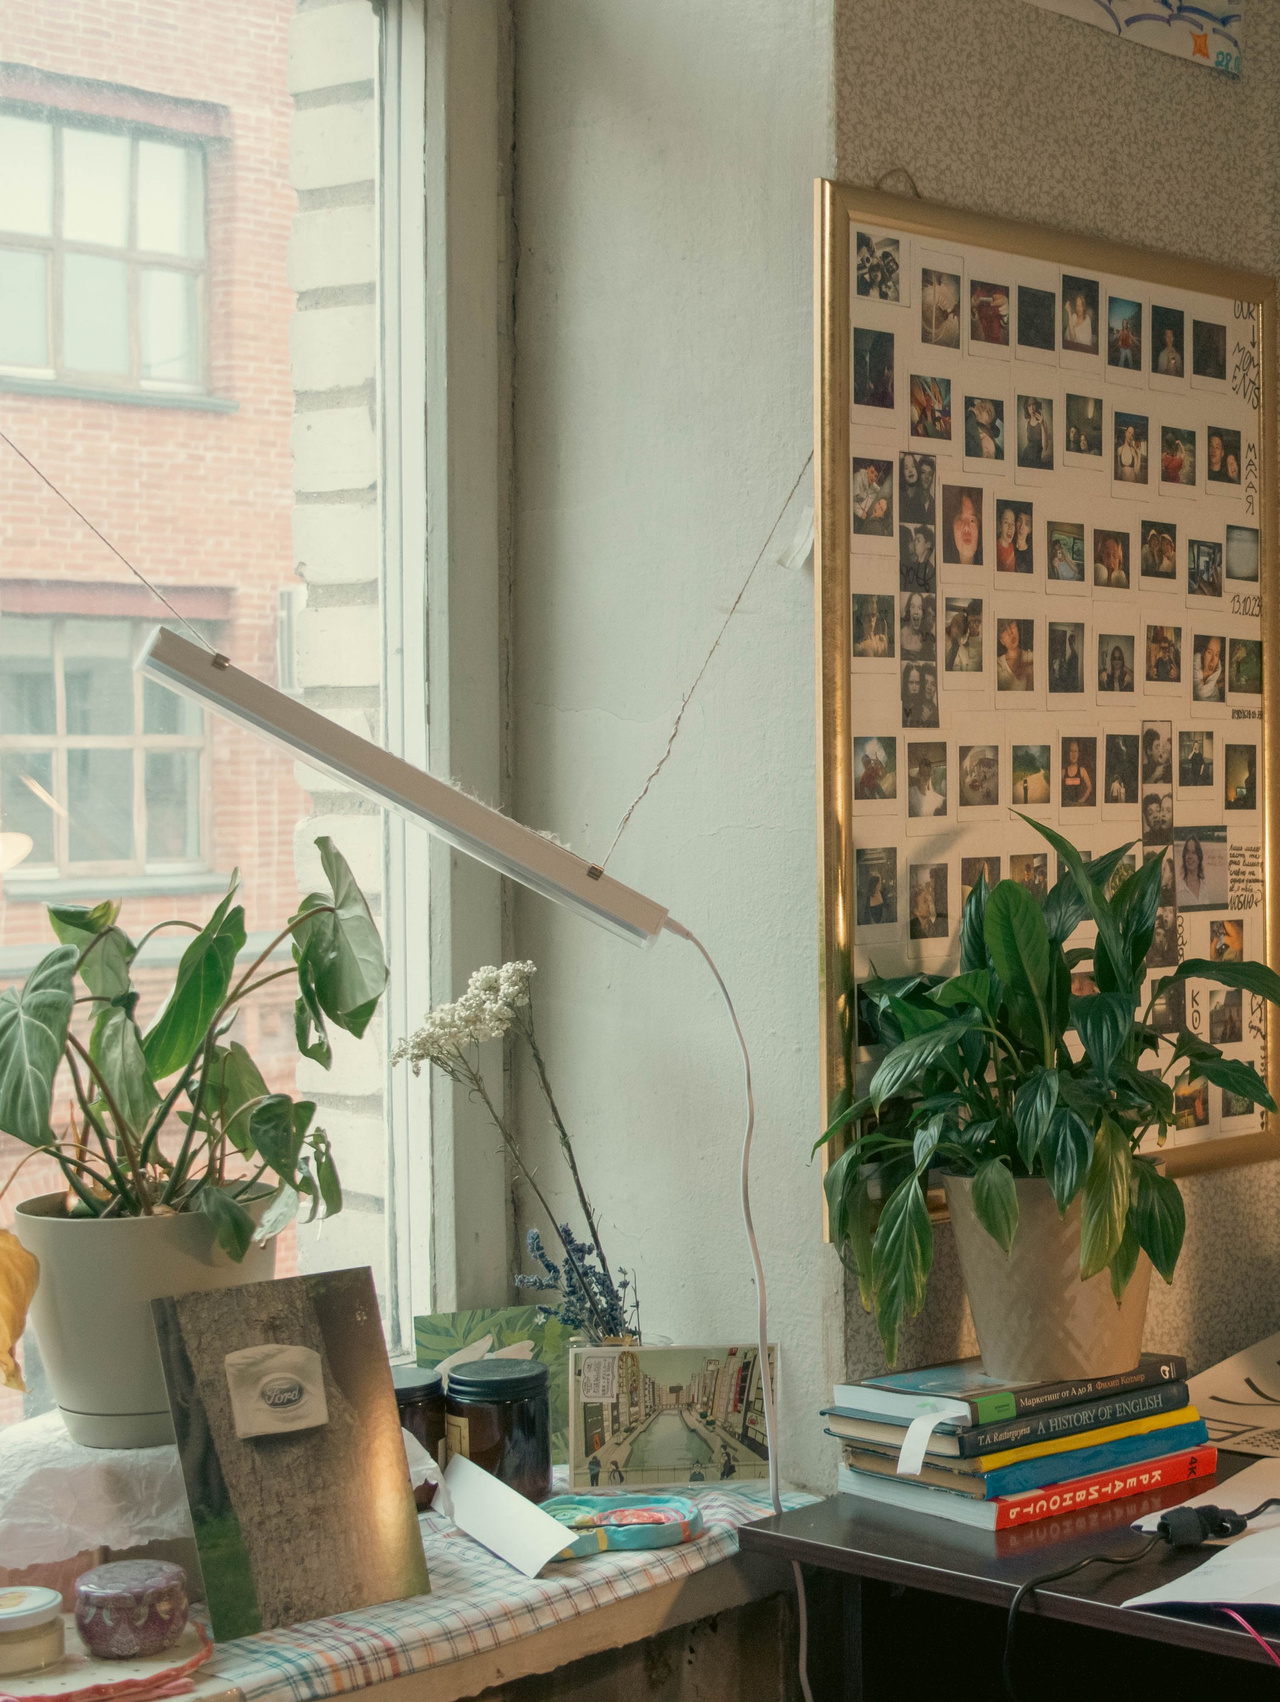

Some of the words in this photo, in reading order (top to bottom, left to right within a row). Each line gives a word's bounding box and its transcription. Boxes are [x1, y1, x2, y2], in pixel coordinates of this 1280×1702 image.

[1191, 989, 1203, 1036] КО
[265, 1385, 301, 1404] Ford
[1019, 1391, 1061, 1408] Маркетинг
[1061, 1390, 1070, 1398] от
[1070, 1387, 1078, 1396] А
[1078, 1386, 1086, 1395] до
[1086, 1383, 1093, 1393] Я
[1120, 1373, 1146, 1386] Котлер
[1037, 1421, 1046, 1435] A
[1049, 1408, 1096, 1431] HISTORY
[1097, 1405, 1113, 1421] OF
[1115, 1393, 1163, 1417] ENGLISH
[1009, 1469, 1162, 1519] КРЕАТИВНОСТЬ
